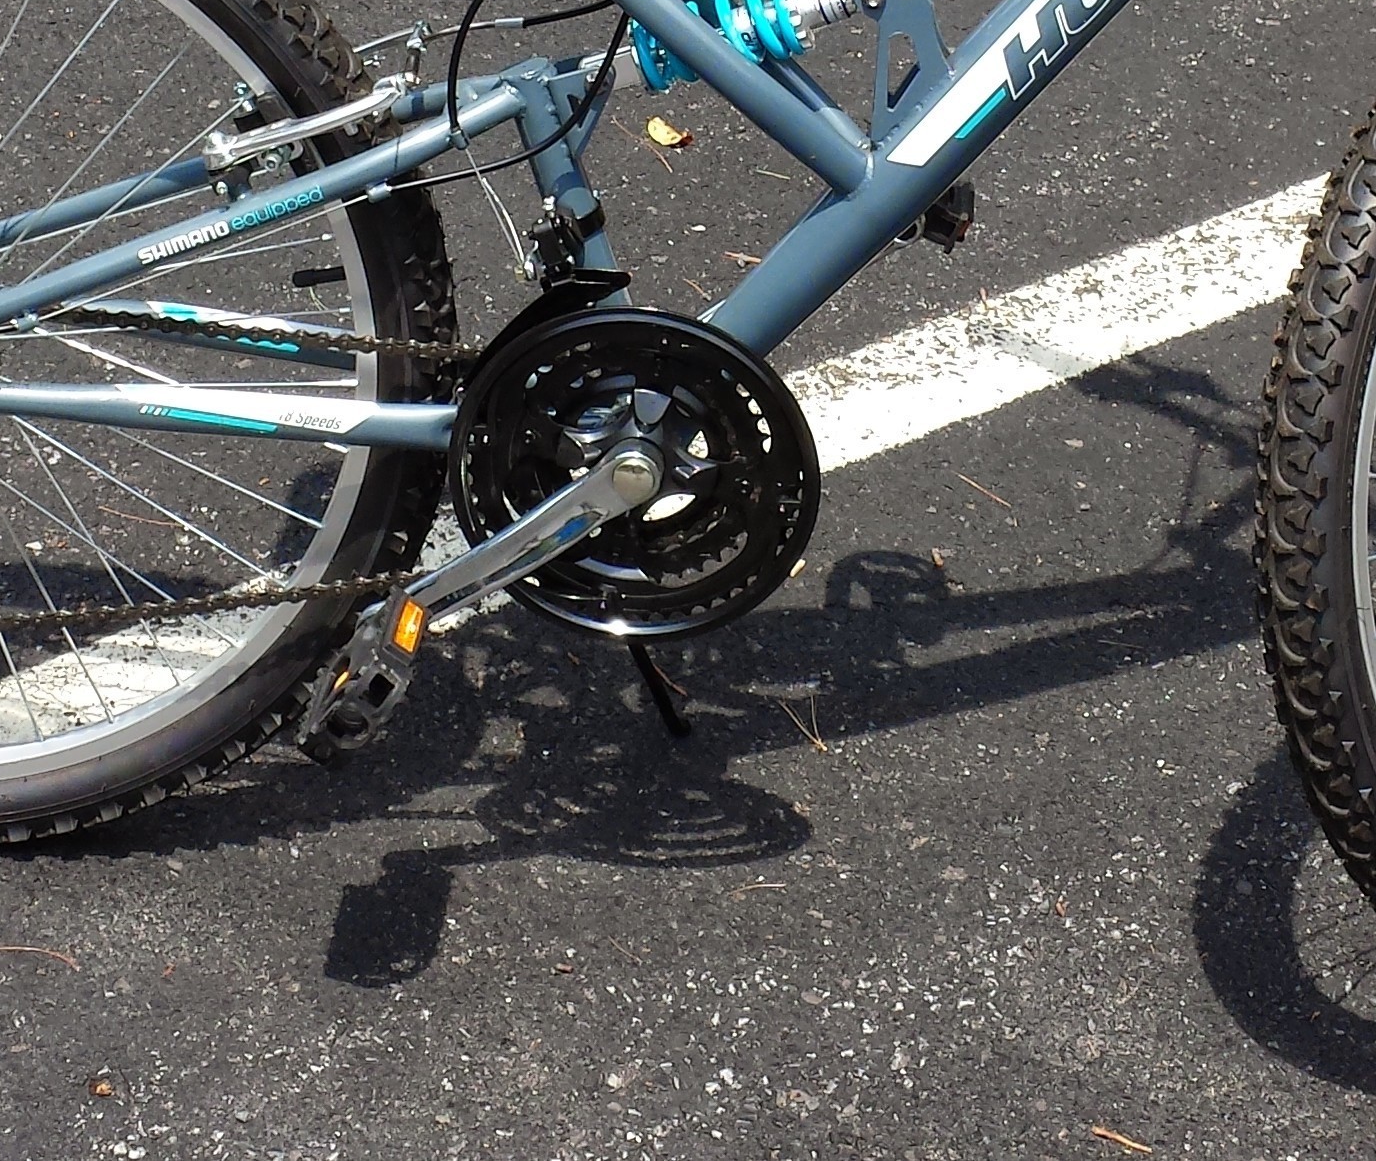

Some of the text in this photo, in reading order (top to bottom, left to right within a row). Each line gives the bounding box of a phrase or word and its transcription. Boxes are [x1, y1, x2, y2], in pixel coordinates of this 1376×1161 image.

[137, 184, 324, 264] SHIMANO equipped
[295, 412, 342, 430] Speeds
